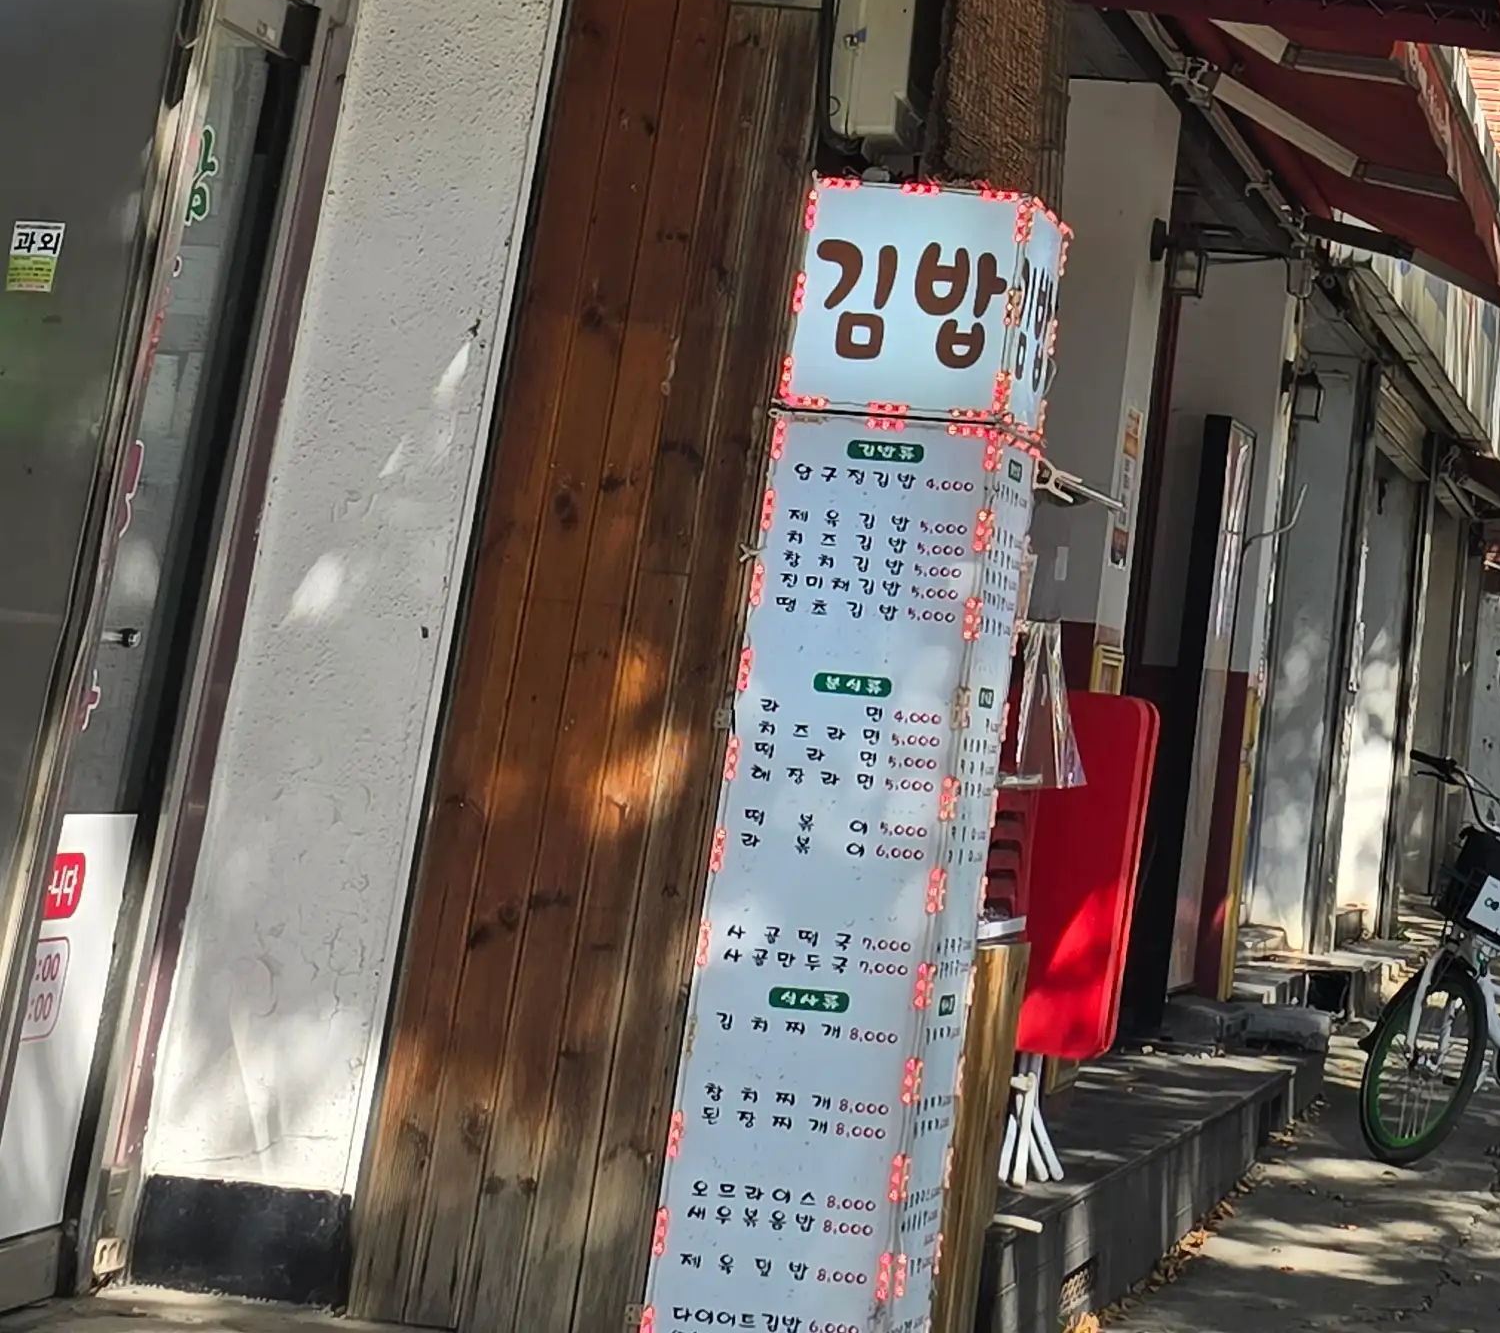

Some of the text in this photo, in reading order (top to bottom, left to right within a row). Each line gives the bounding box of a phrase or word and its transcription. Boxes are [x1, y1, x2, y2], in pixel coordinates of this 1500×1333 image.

[13, 231, 61, 255] 과외
[816, 237, 1008, 369] 김밥
[857, 442, 916, 461] 김밥류
[794, 462, 975, 493] 압구정김밥 4,000
[787, 508, 969, 536] 제육김밥 5,000
[787, 529, 966, 558] 치즈김밥 5,000
[913, 562, 963, 579] 5,000
[779, 572, 960, 601] 진미채김밥 5,000
[775, 595, 957, 624] 땡초김밥 5,000
[760, 697, 943, 726] 라면 4,000
[758, 720, 941, 749] 치즈라면 5,000
[887, 754, 938, 771] 5,000
[884, 777, 935, 793] 5,000
[879, 820, 929, 838] 5,000
[875, 844, 925, 861] 6,000
[861, 936, 912, 954] 7,000
[858, 960, 909, 977] 7,000
[716, 1011, 899, 1045] 김치찌개 8,000
[704, 1082, 890, 1116] 참치찌개 8,000
[701, 1106, 887, 1140] 된장찌개 8,000
[691, 1179, 877, 1212] 오므라이스 8,000
[822, 1219, 875, 1237] 8,000
[815, 1267, 868, 1286] 8,000
